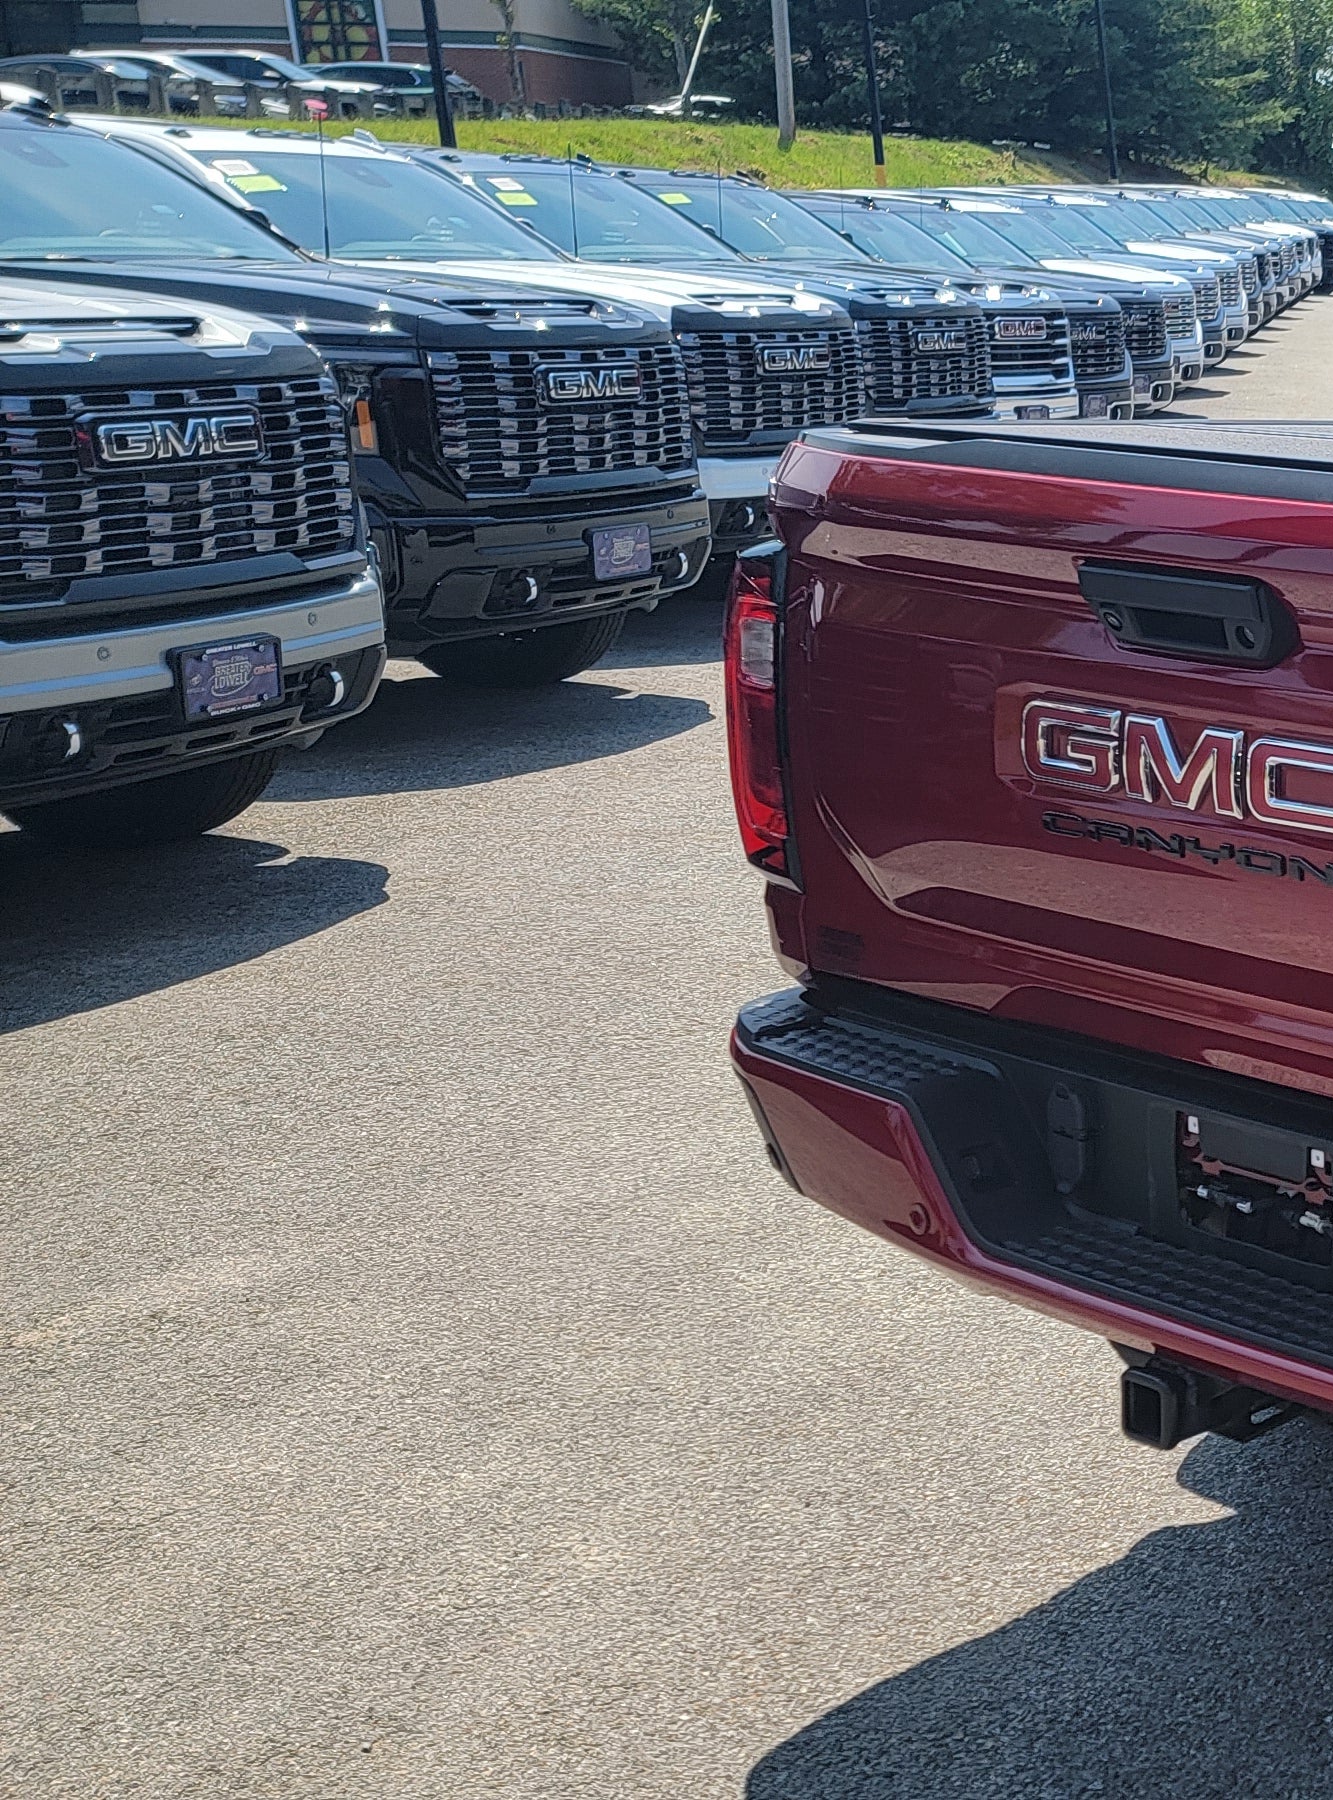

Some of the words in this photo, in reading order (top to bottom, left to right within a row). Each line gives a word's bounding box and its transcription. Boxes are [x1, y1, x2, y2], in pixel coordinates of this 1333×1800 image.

[1001, 319, 1046, 337] GMC
[917, 332, 967, 351] GMC
[763, 347, 832, 371] GMC
[548, 369, 641, 398] GMC
[98, 415, 260, 461] GMC
